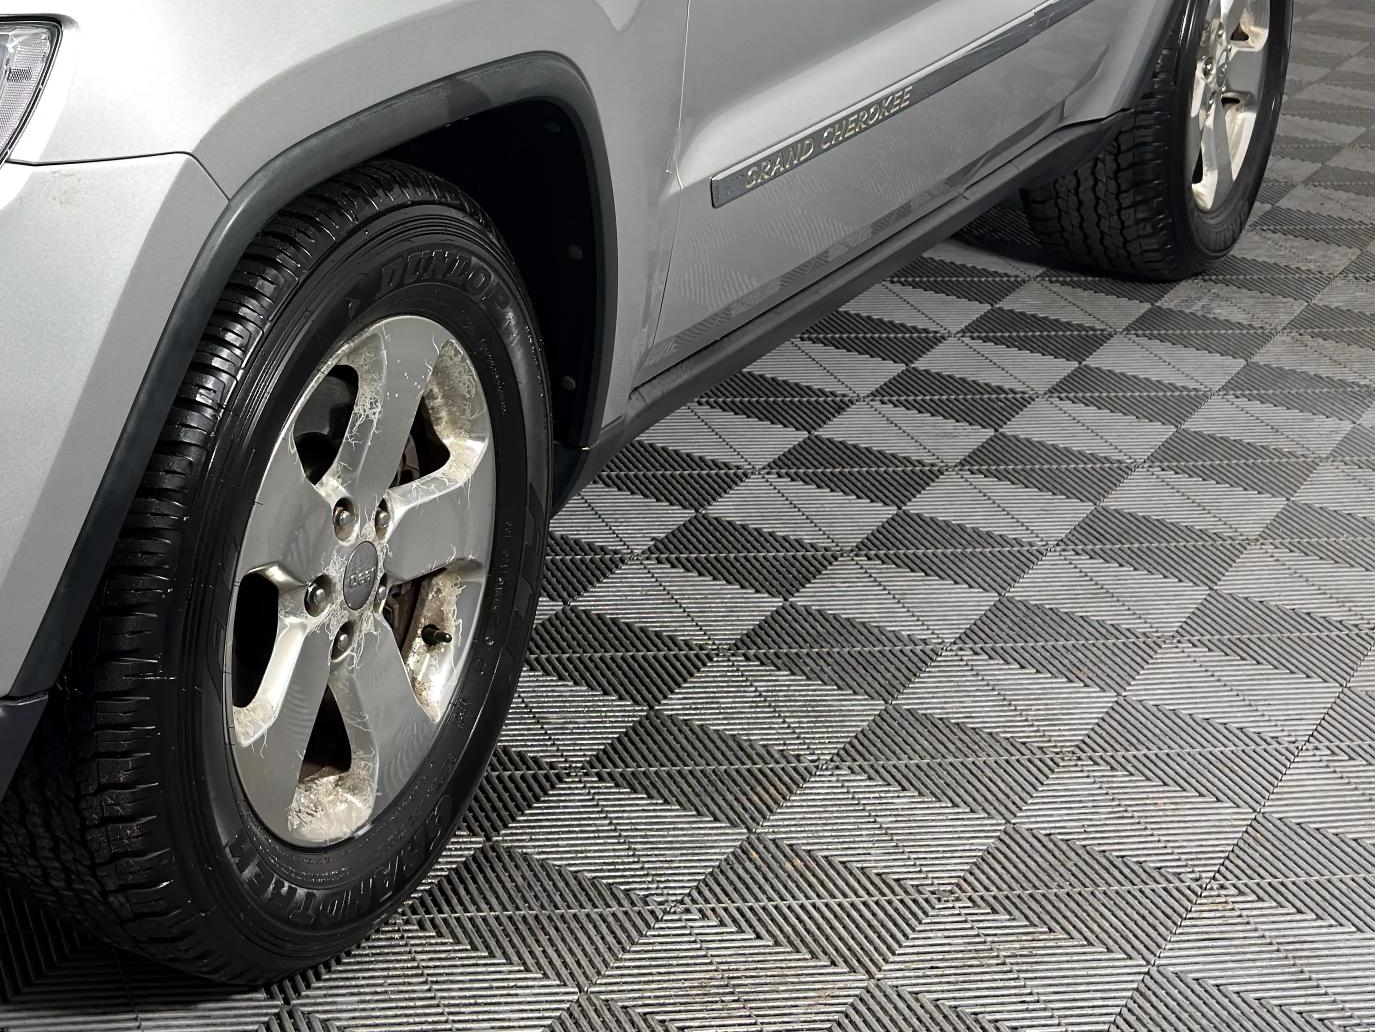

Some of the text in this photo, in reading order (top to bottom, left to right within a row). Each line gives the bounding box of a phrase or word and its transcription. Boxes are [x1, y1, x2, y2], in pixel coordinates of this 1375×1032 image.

[744, 85, 913, 189] GRAND CHEROKEE
[375, 249, 511, 311] DUNLOP
